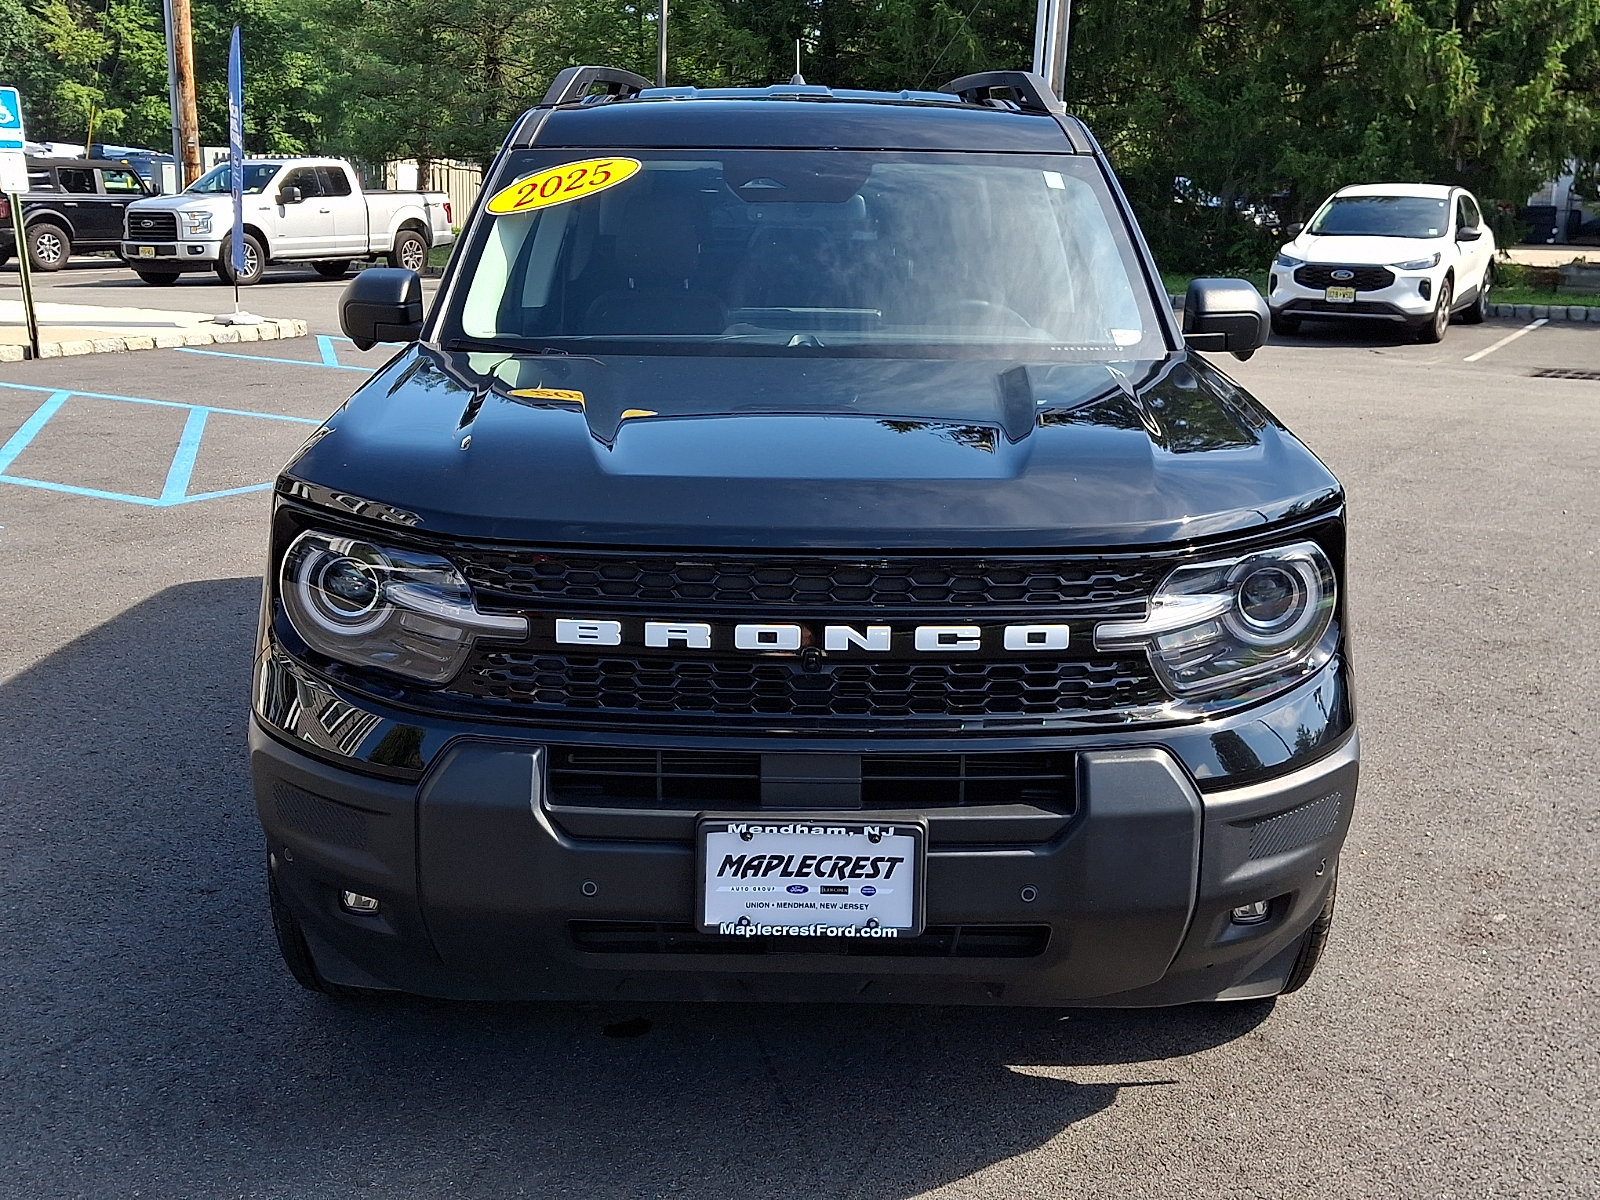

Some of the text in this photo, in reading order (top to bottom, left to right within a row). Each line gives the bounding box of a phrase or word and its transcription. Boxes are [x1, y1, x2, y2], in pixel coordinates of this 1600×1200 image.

[513, 162, 614, 208] 2025
[555, 618, 1070, 651] BRONCO
[727, 823, 895, 837] Mendham, NJ
[716, 854, 905, 881] MAPLECREST
[776, 902, 818, 910] MENDHAM,
[719, 922, 898, 938] MaplecrestFord.com
